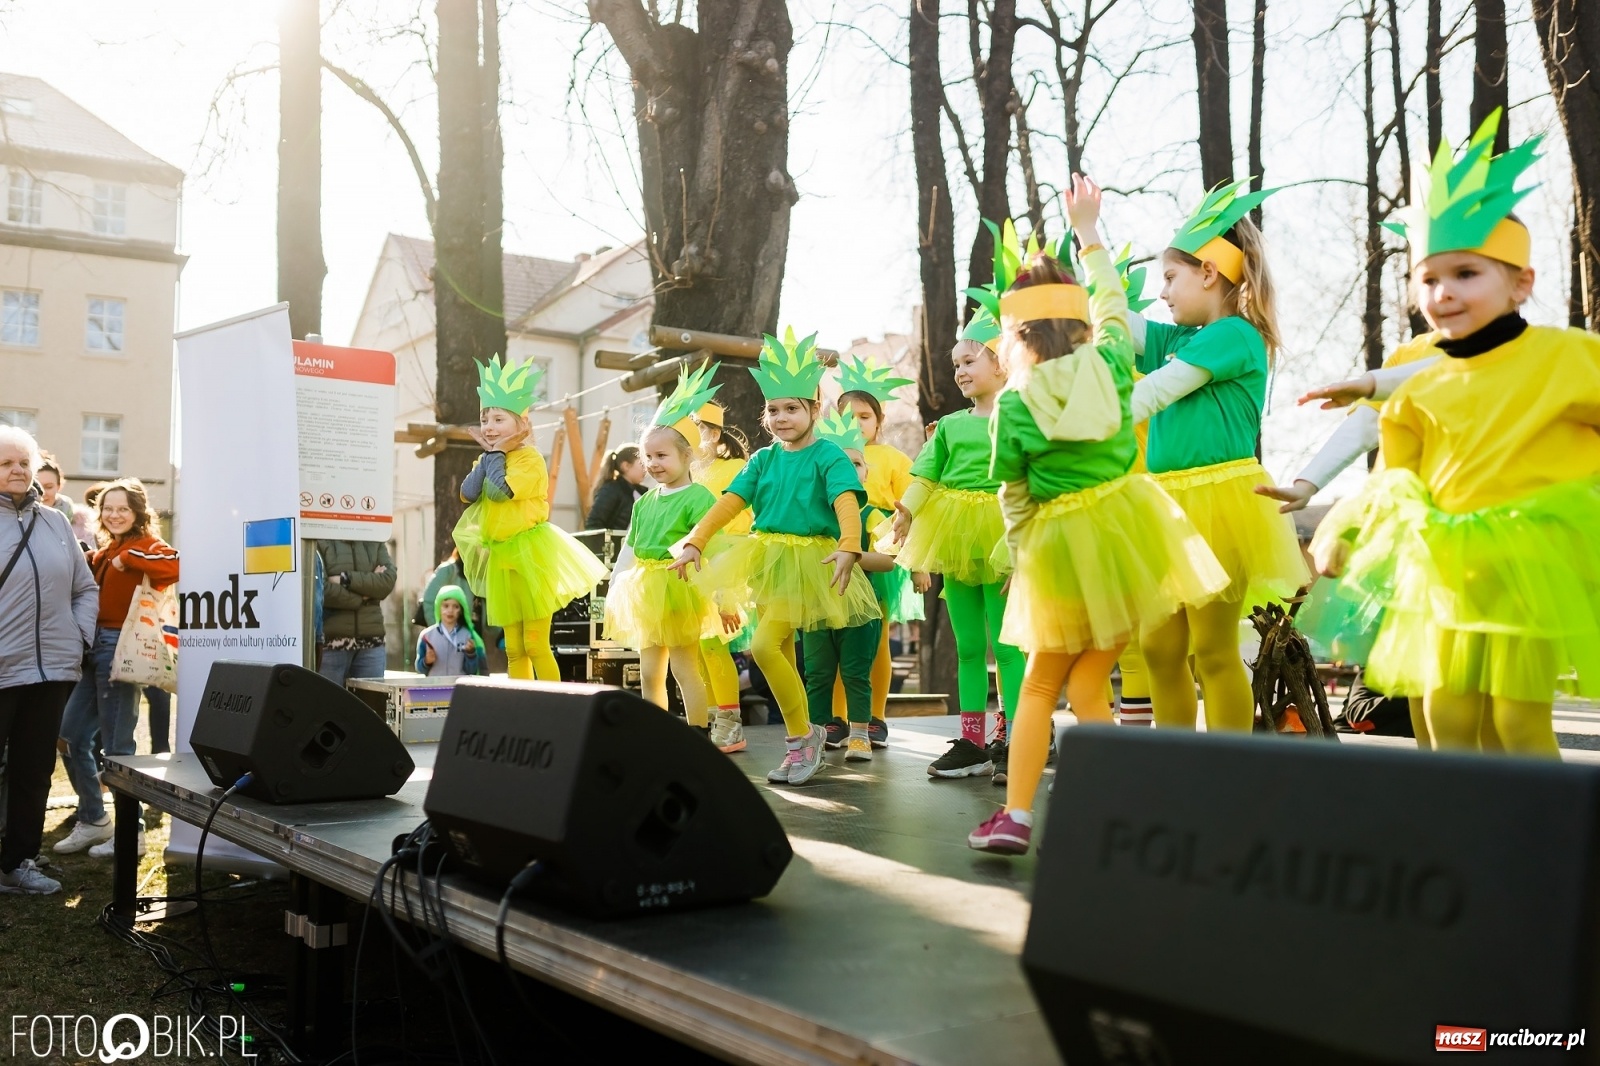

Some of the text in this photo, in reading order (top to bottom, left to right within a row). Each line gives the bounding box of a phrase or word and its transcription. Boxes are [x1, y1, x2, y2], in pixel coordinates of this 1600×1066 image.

[178, 573, 260, 630] mdk
[178, 634, 221, 650] łodzieżowy
[222, 634, 238, 647] dom
[239, 634, 265, 650] kultury
[266, 634, 297, 647] racibórz
[455, 730, 554, 770] POL-AUDIO
[1100, 818, 1468, 931] POL-AUDIO
